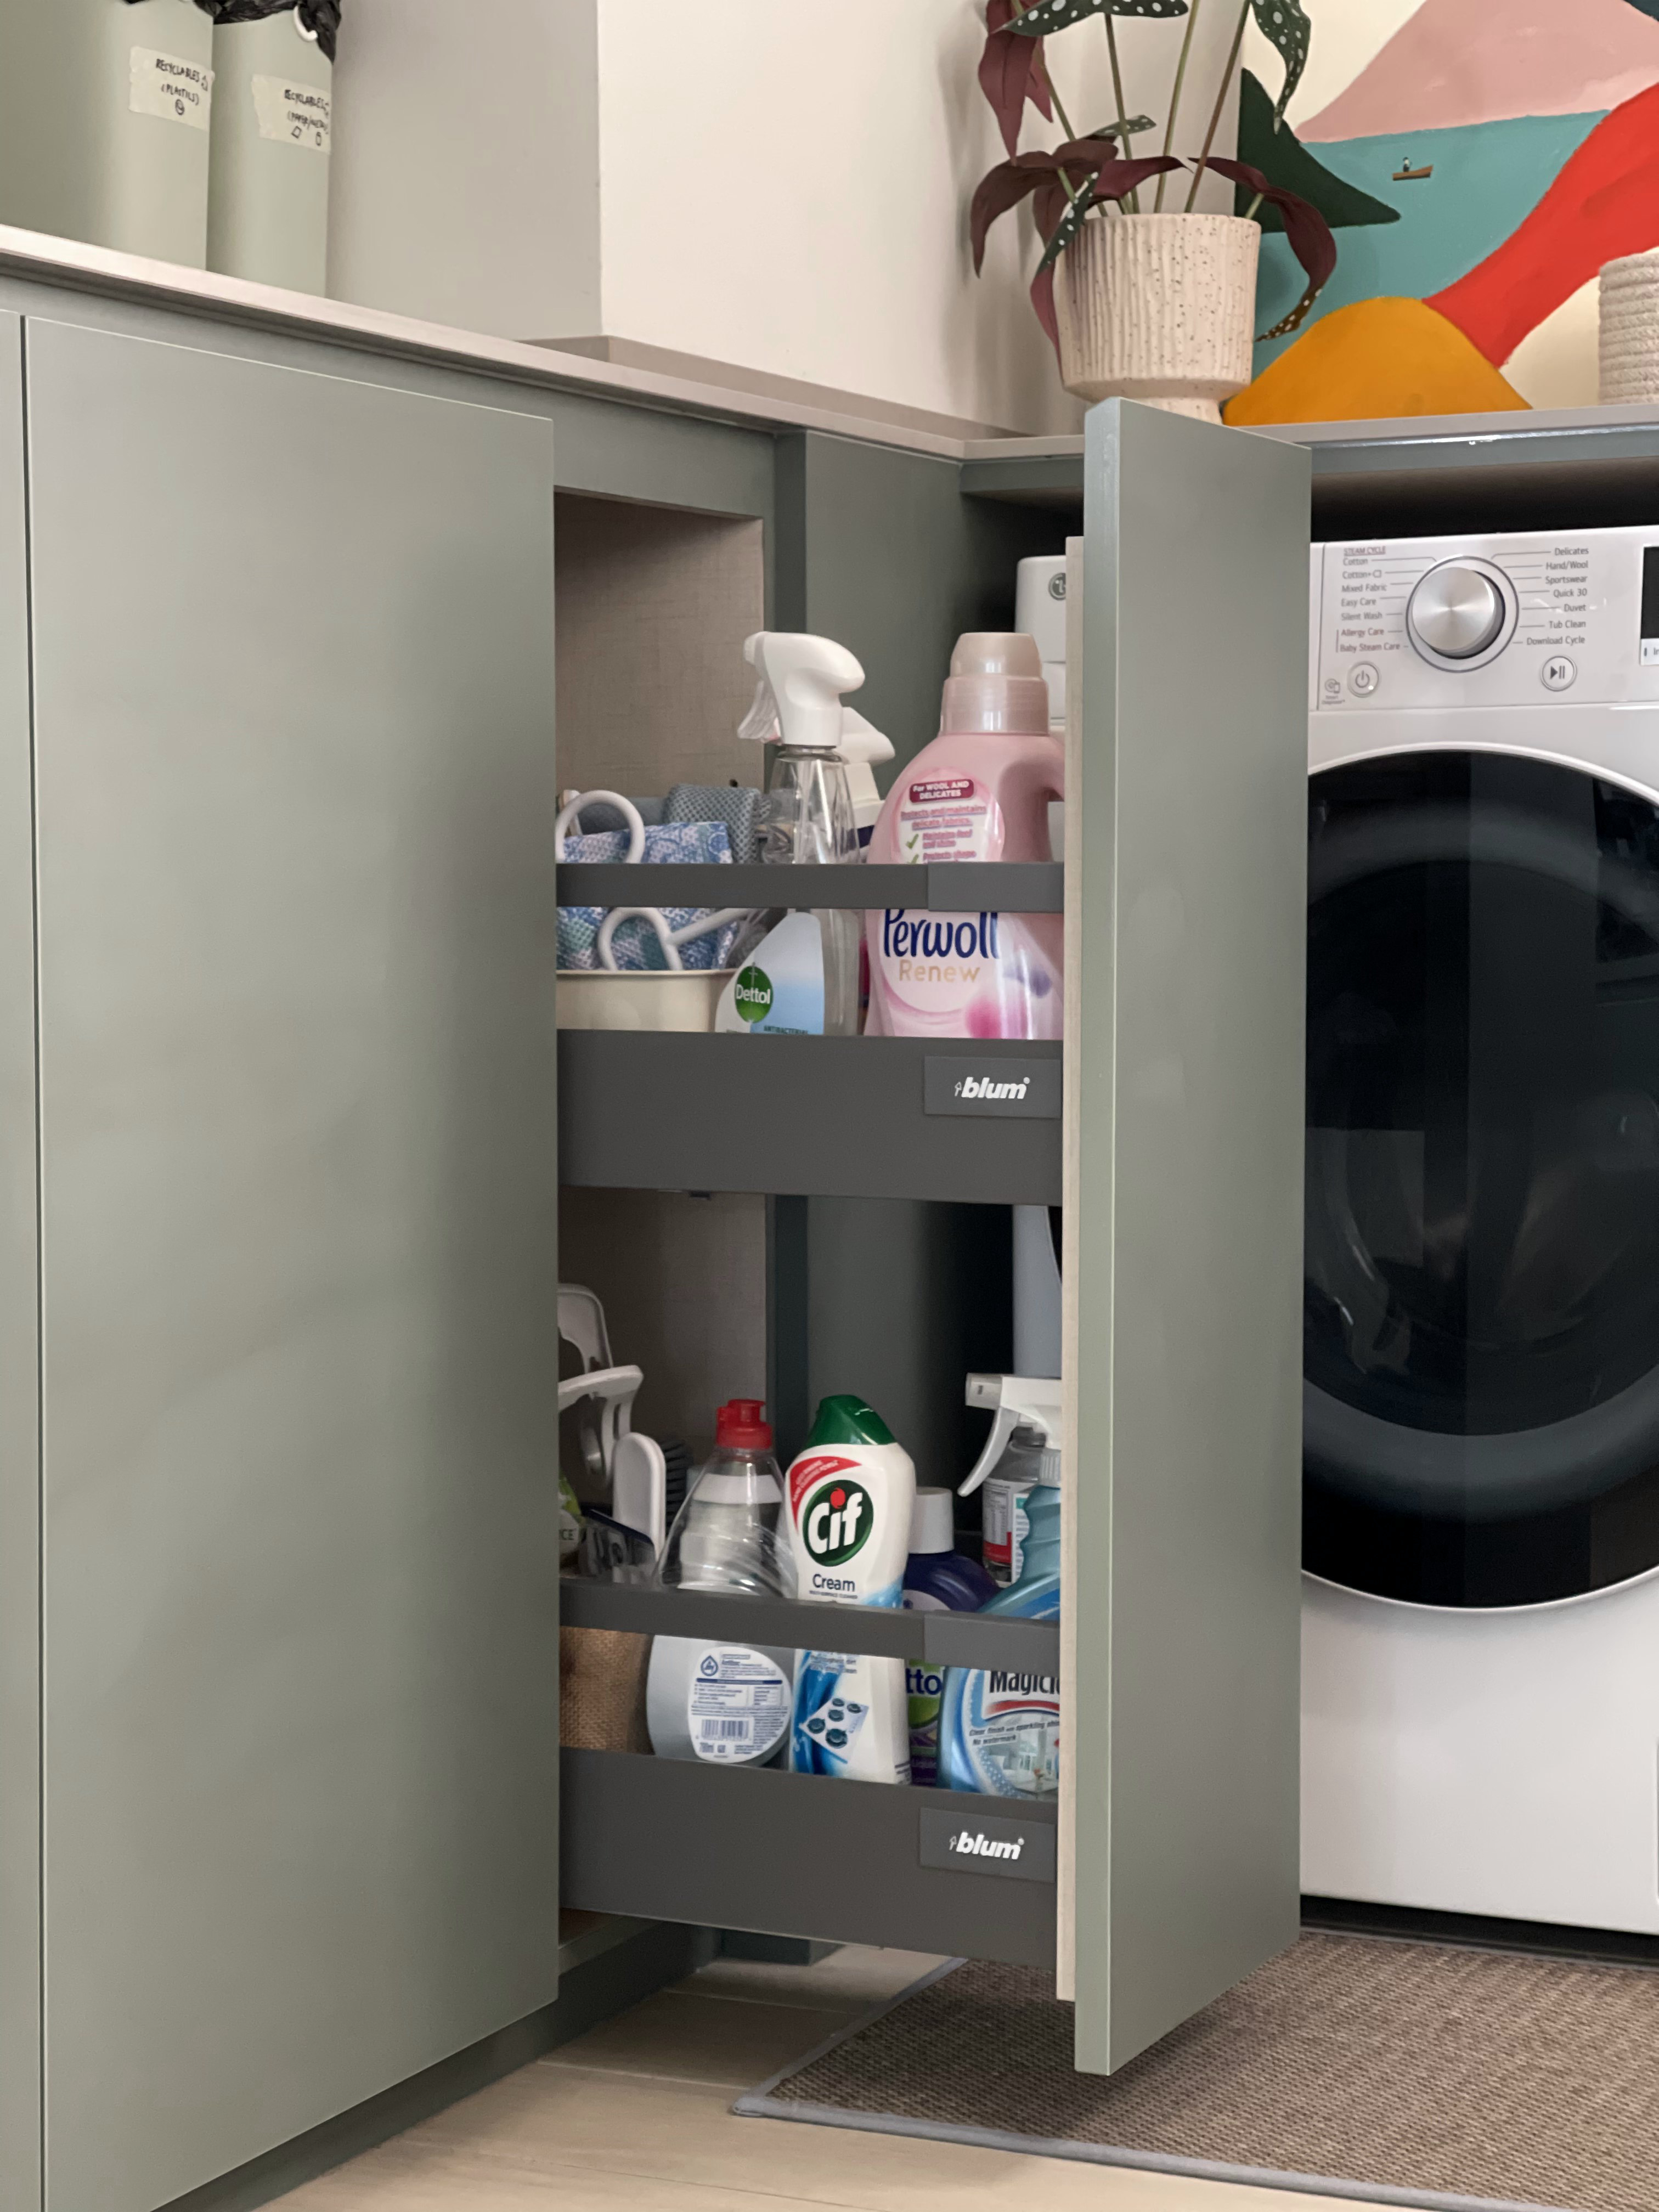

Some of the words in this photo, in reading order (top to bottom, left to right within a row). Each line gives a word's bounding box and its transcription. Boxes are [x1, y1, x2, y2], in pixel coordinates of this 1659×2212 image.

[156, 59, 200, 82] RECYCLABLES
[1367, 546, 1386, 554] CYCLE
[1554, 548, 1589, 556] Delicates
[1545, 560, 1588, 570] Hand/Wool
[1545, 575, 1588, 585] Sportswear
[1341, 584, 1363, 592] Mixed
[1365, 583, 1387, 591] Fabric
[1553, 589, 1575, 599] Quick
[1577, 588, 1588, 597] 30
[1341, 598, 1357, 608] Easy
[1359, 597, 1376, 606] Care
[1564, 603, 1586, 612] Duvet
[1341, 612, 1361, 620] Silent
[1364, 611, 1383, 619] Wash
[1549, 620, 1563, 629] Tub
[1565, 619, 1587, 628] Clean
[1341, 629, 1365, 638] Allergy
[1367, 627, 1384, 635] Care
[1526, 636, 1563, 645] Download
[1565, 635, 1585, 646] Cycle
[1340, 644, 1357, 653] Baby
[1359, 643, 1382, 651] Steam
[1383, 642, 1400, 650] Care
[951, 781, 970, 789] AND
[919, 789, 962, 799] DELICATES
[883, 909, 1000, 960] Perwoll
[899, 959, 980, 983] Renew
[736, 984, 771, 1005] Dettol
[961, 1076, 1027, 1099] blum
[808, 1487, 863, 1554] Cif
[812, 1573, 855, 1592] Cream
[906, 1668, 943, 1696] tto
[956, 1831, 1021, 1860] blum
